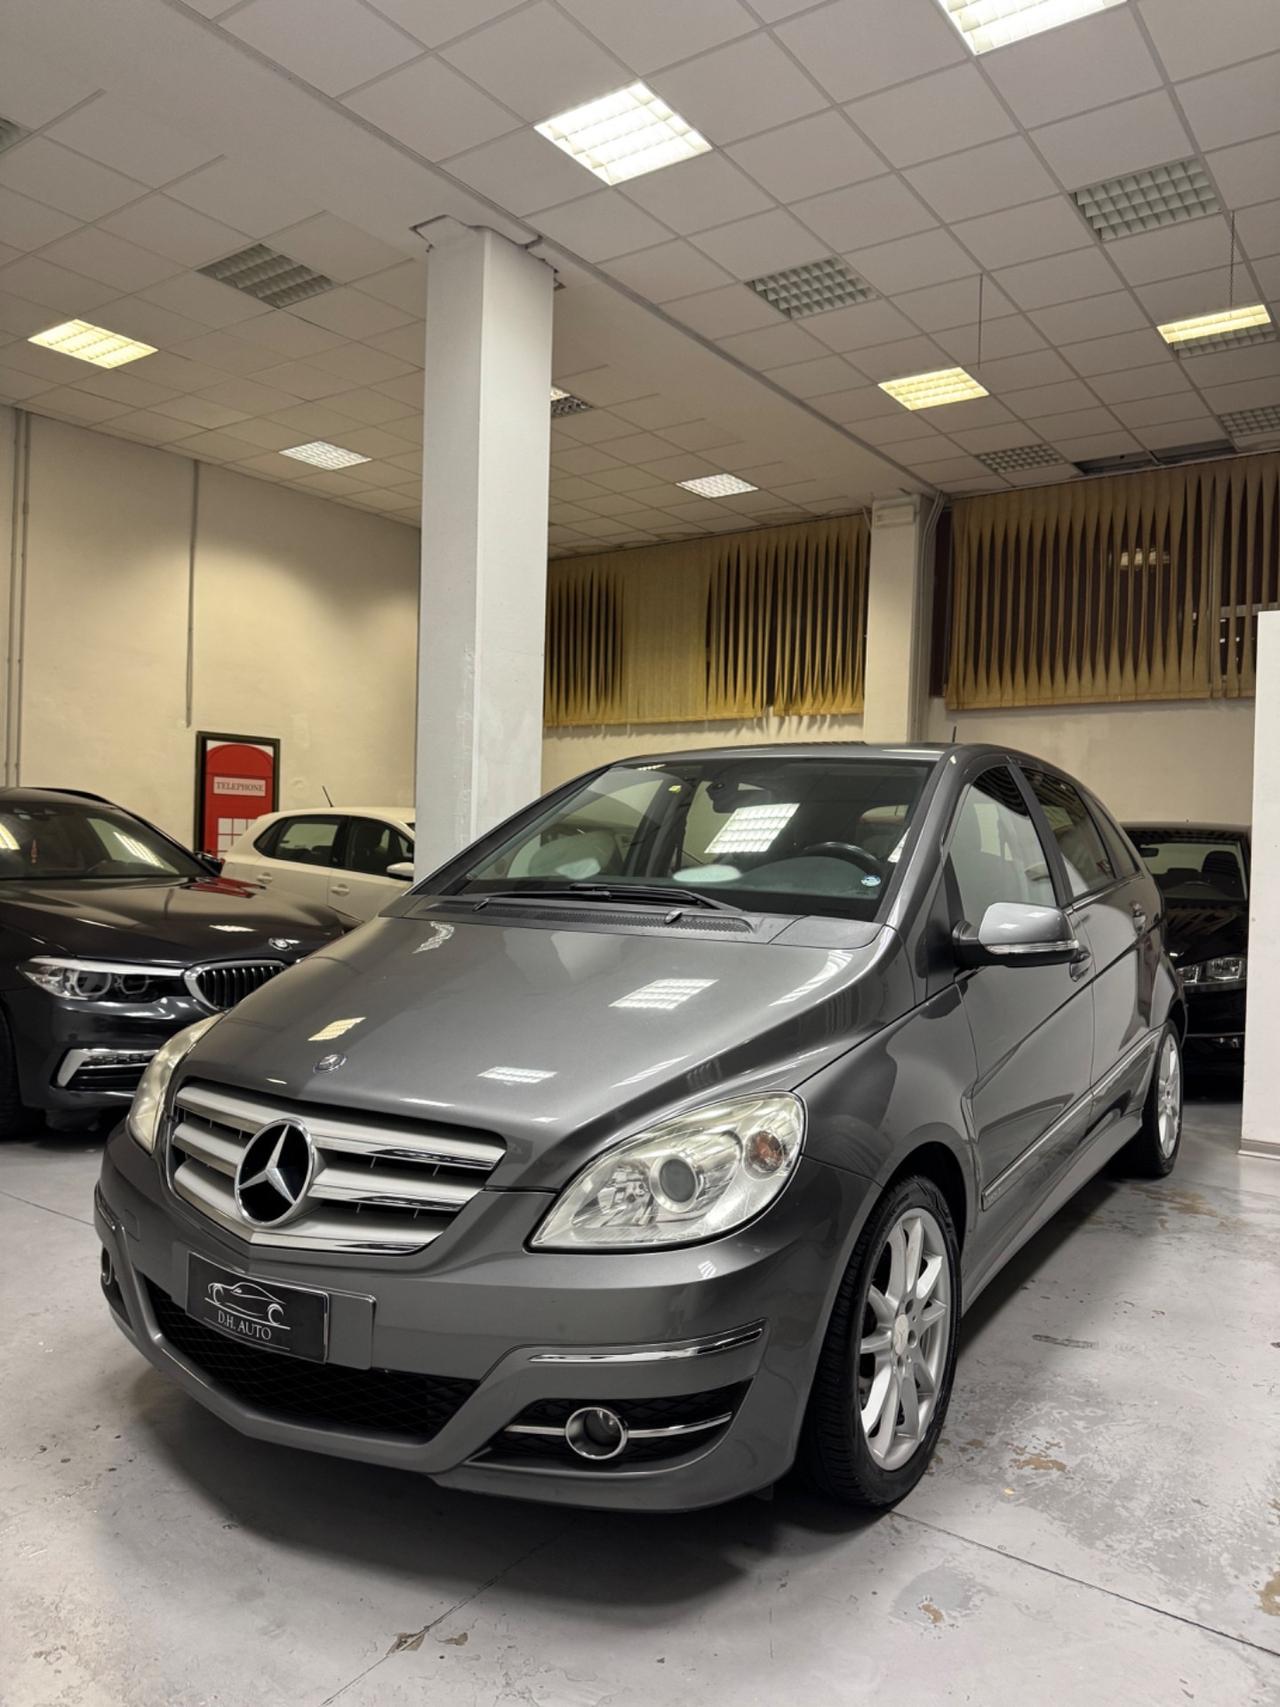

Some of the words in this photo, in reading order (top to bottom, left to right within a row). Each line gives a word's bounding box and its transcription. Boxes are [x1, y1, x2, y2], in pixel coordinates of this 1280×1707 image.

[216, 781, 264, 792] TELEPHONE
[218, 1310, 236, 1329] D.H.
[237, 1320, 272, 1340] AUTO
